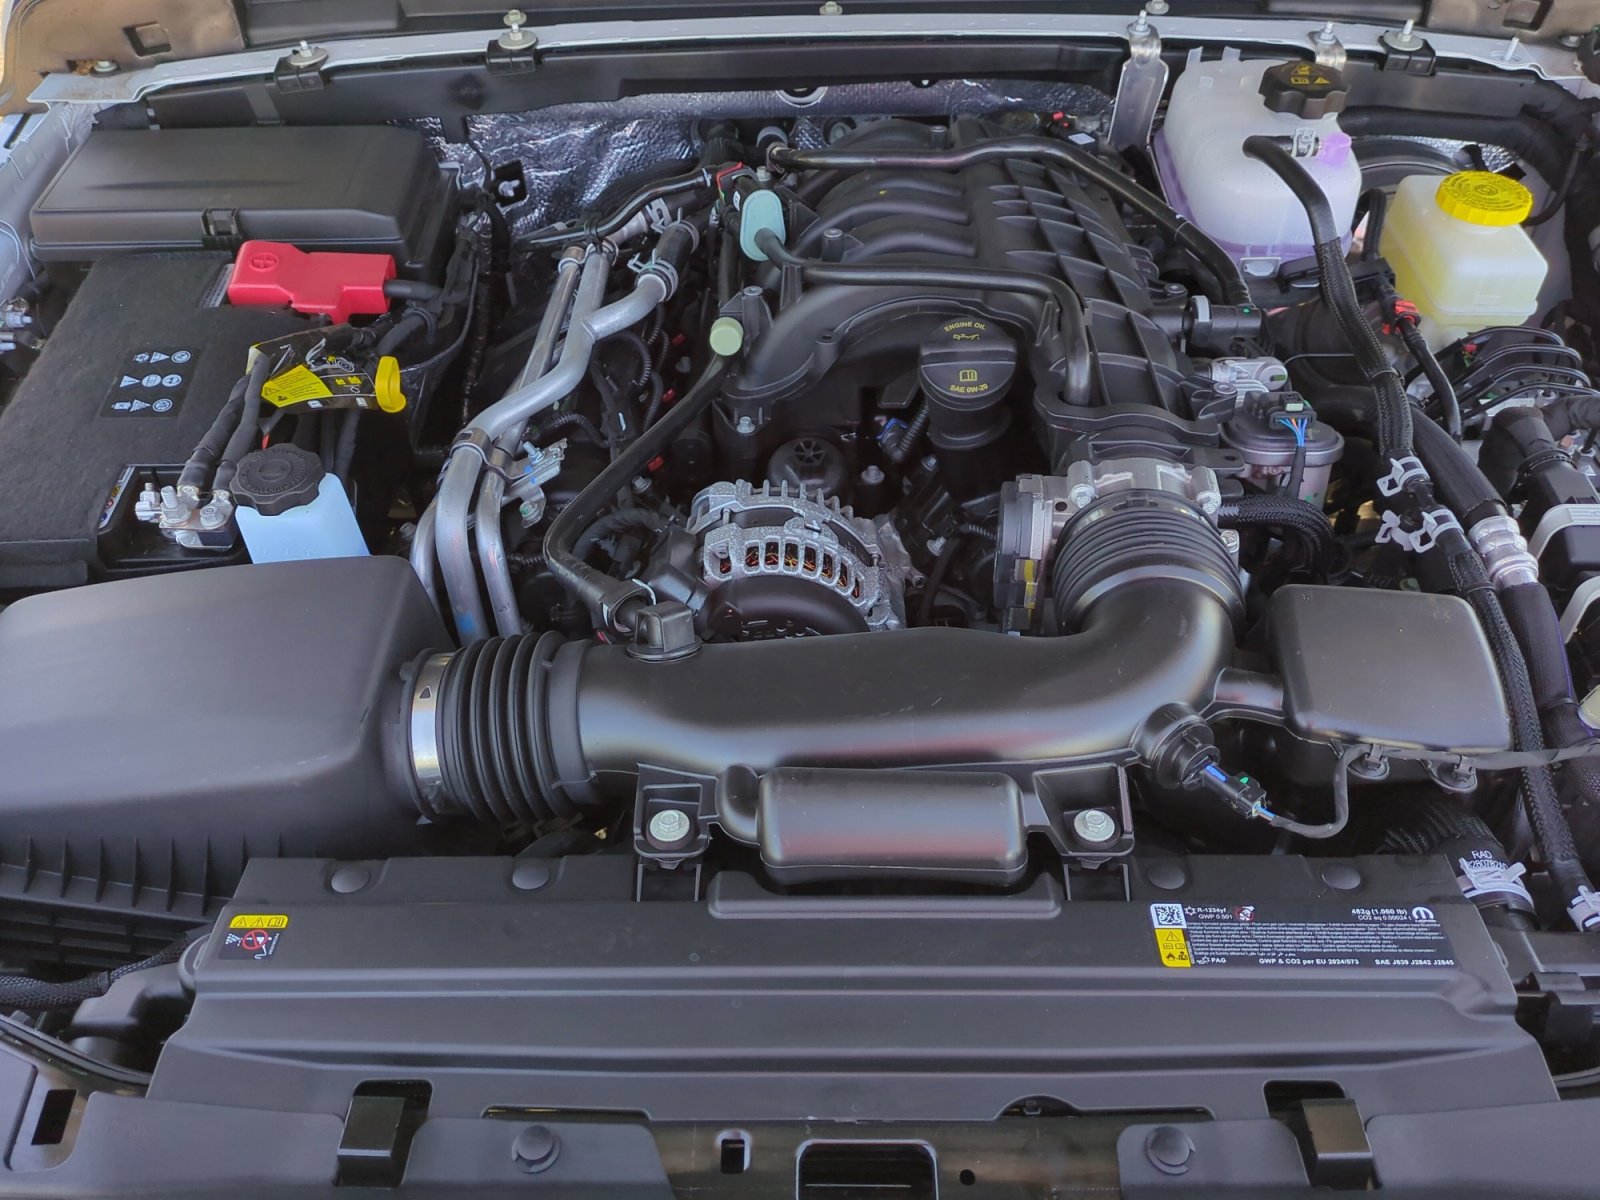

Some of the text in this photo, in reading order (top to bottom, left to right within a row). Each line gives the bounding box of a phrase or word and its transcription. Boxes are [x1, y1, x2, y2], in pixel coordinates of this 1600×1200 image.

[943, 321, 987, 332] ENGINE OIL
[949, 383, 989, 393] SAE 0W-20
[1471, 850, 1493, 859] RAD
[1196, 907, 1227, 915] R-1234yf
